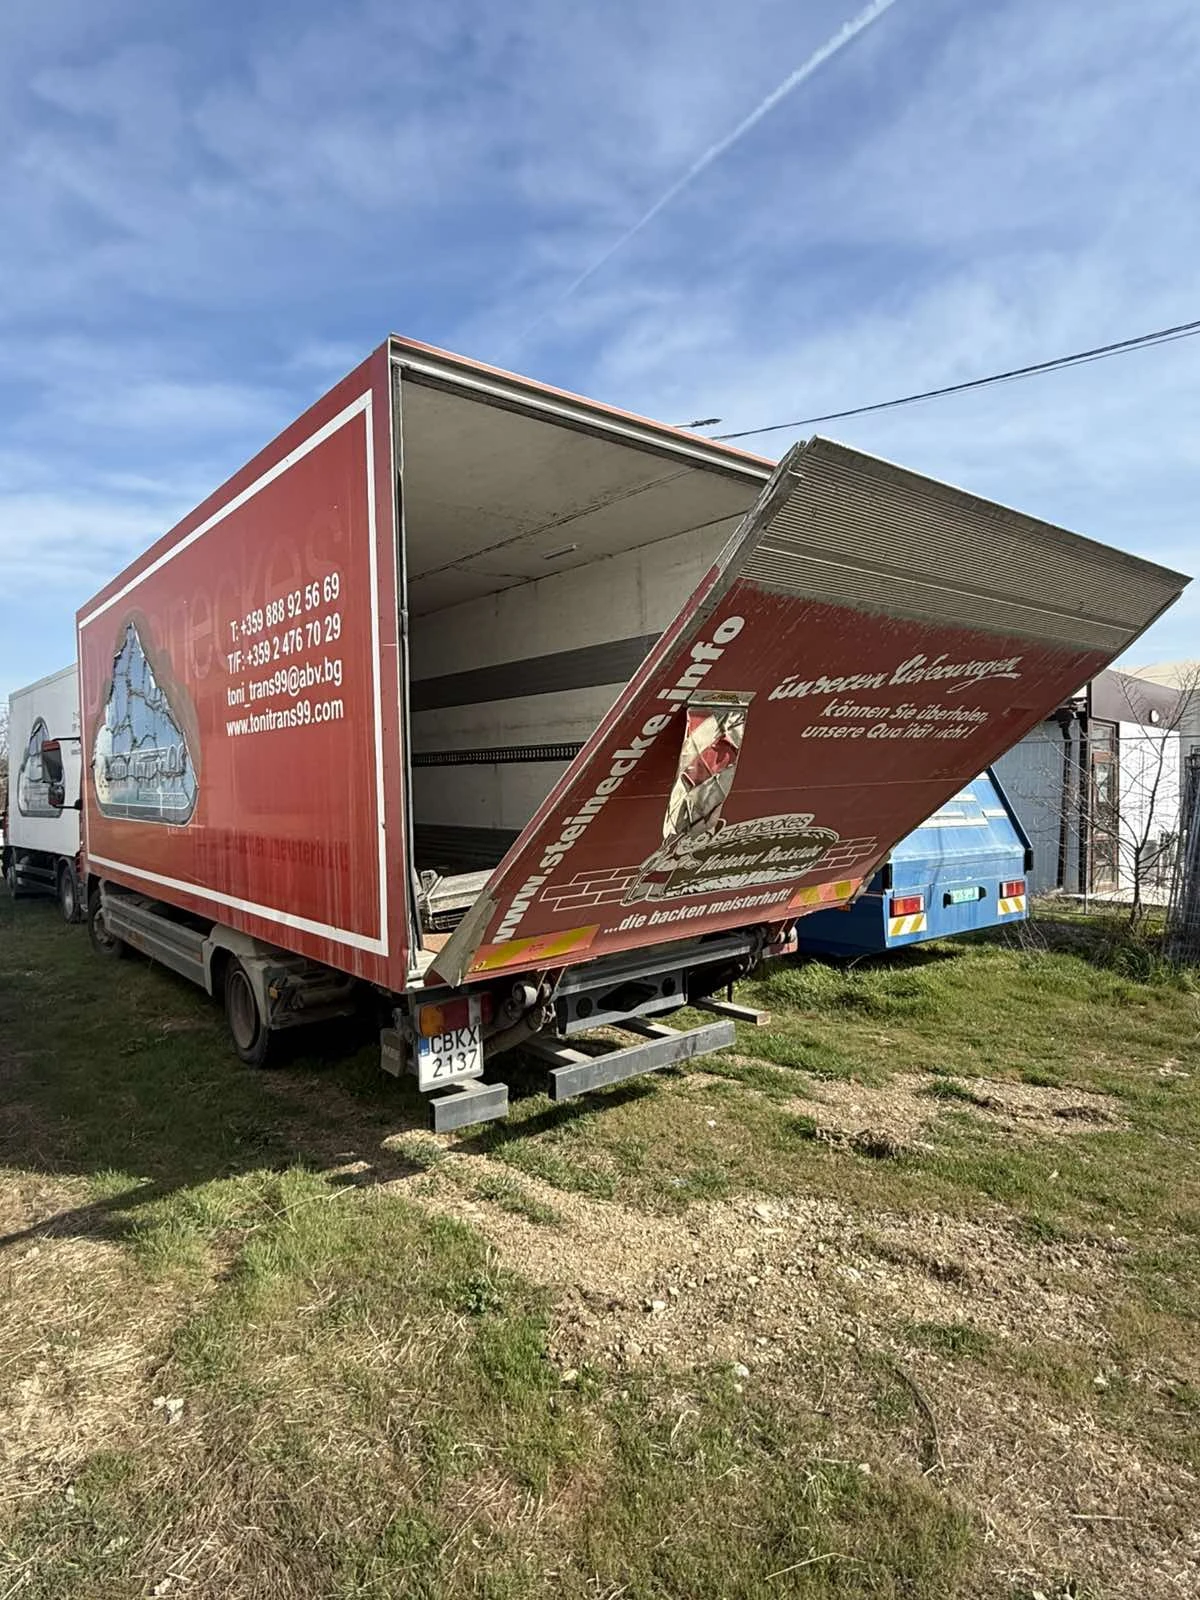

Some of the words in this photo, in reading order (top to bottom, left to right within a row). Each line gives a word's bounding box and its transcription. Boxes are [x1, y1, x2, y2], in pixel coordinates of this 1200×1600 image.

[230, 620, 239, 642] T:
[240, 608, 264, 637] +359
[265, 598, 285, 628] 888
[287, 590, 302, 618] 92
[305, 582, 320, 611] 56
[323, 572, 340, 602] 69
[227, 650, 246, 675] T/F:
[246, 640, 271, 667] +359
[272, 636, 280, 660] 2
[282, 627, 303, 655] 476
[305, 620, 321, 649] 70
[324, 612, 341, 643] 29
[227, 656, 342, 708] toni_trans99@abv.bg
[226, 699, 344, 737] www.tonitrans99.com
[819, 698, 892, 718] können
[889, 703, 917, 720] Sie
[800, 724, 866, 739] unsere
[491, 615, 746, 944] www.steinecke.info
[647, 905, 707, 926] backen
[706, 887, 793, 915] meisterhaft!
[430, 1025, 478, 1055] CBKX
[432, 1048, 478, 1079] 2137
